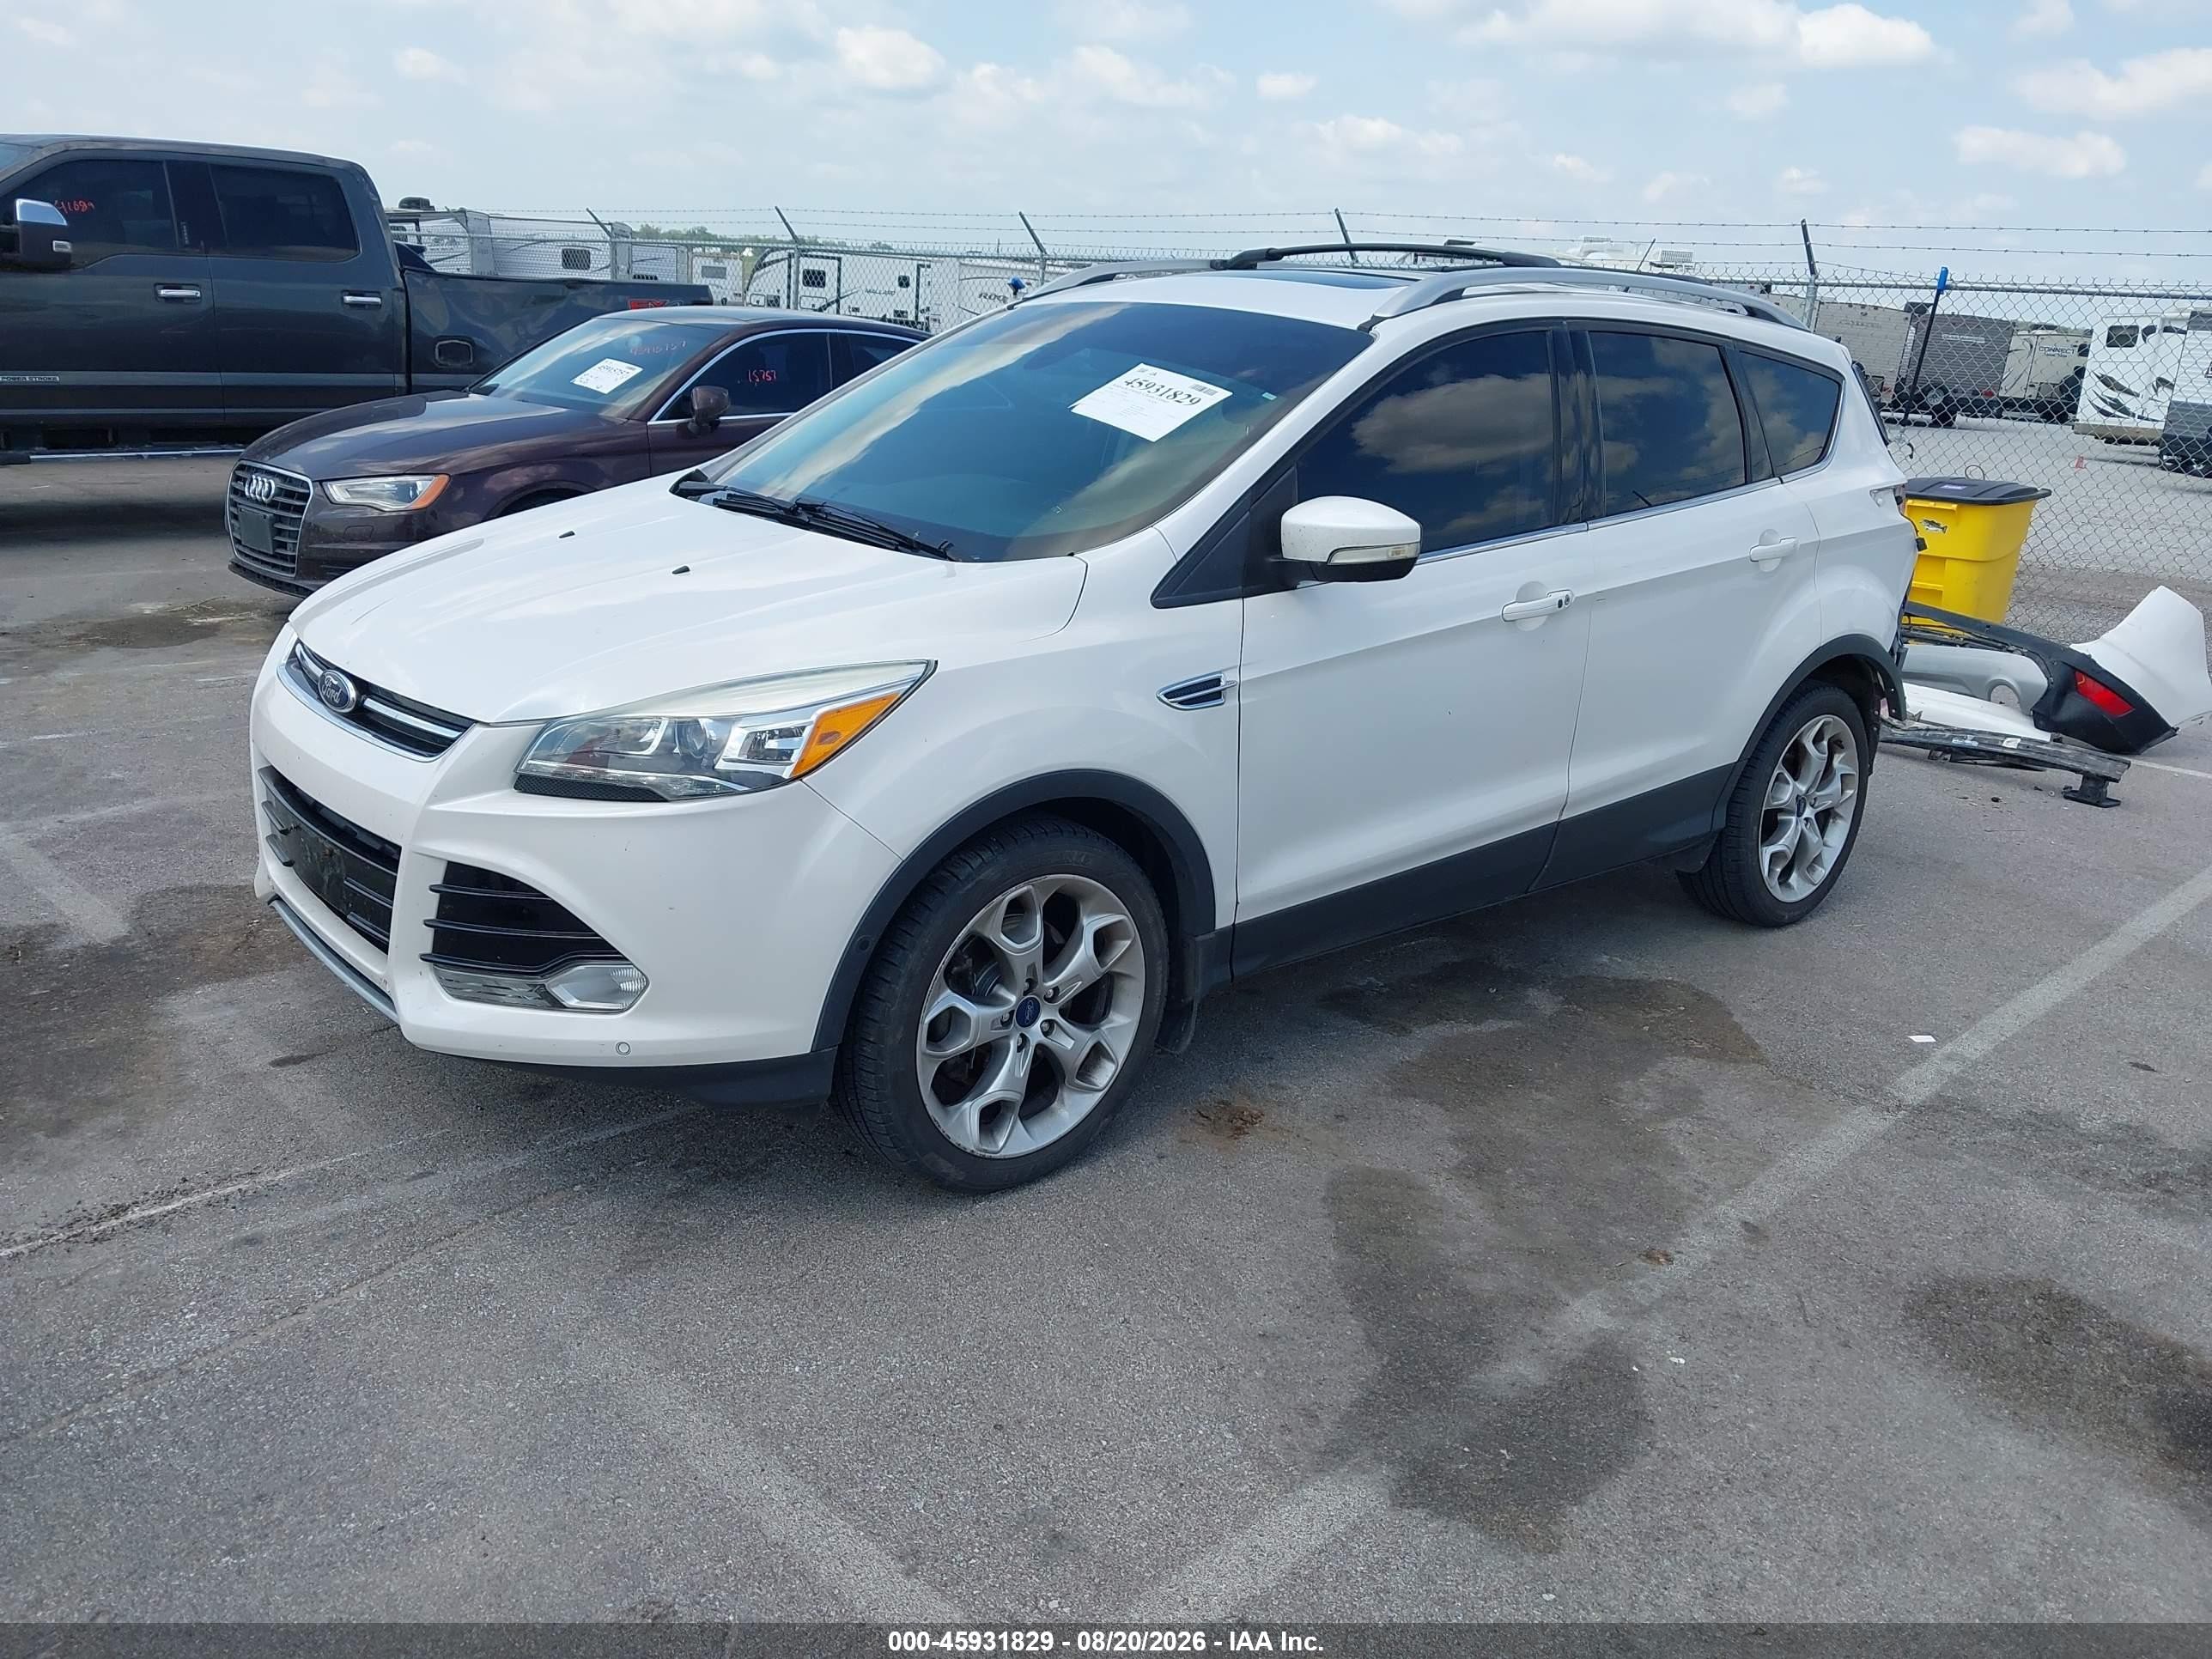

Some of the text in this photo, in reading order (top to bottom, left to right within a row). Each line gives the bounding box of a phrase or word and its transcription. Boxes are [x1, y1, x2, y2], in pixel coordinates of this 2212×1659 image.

[2039, 345, 2075, 355] CONNECT
[1123, 376, 1202, 407] 45931829
[321, 675, 343, 704] Ford
